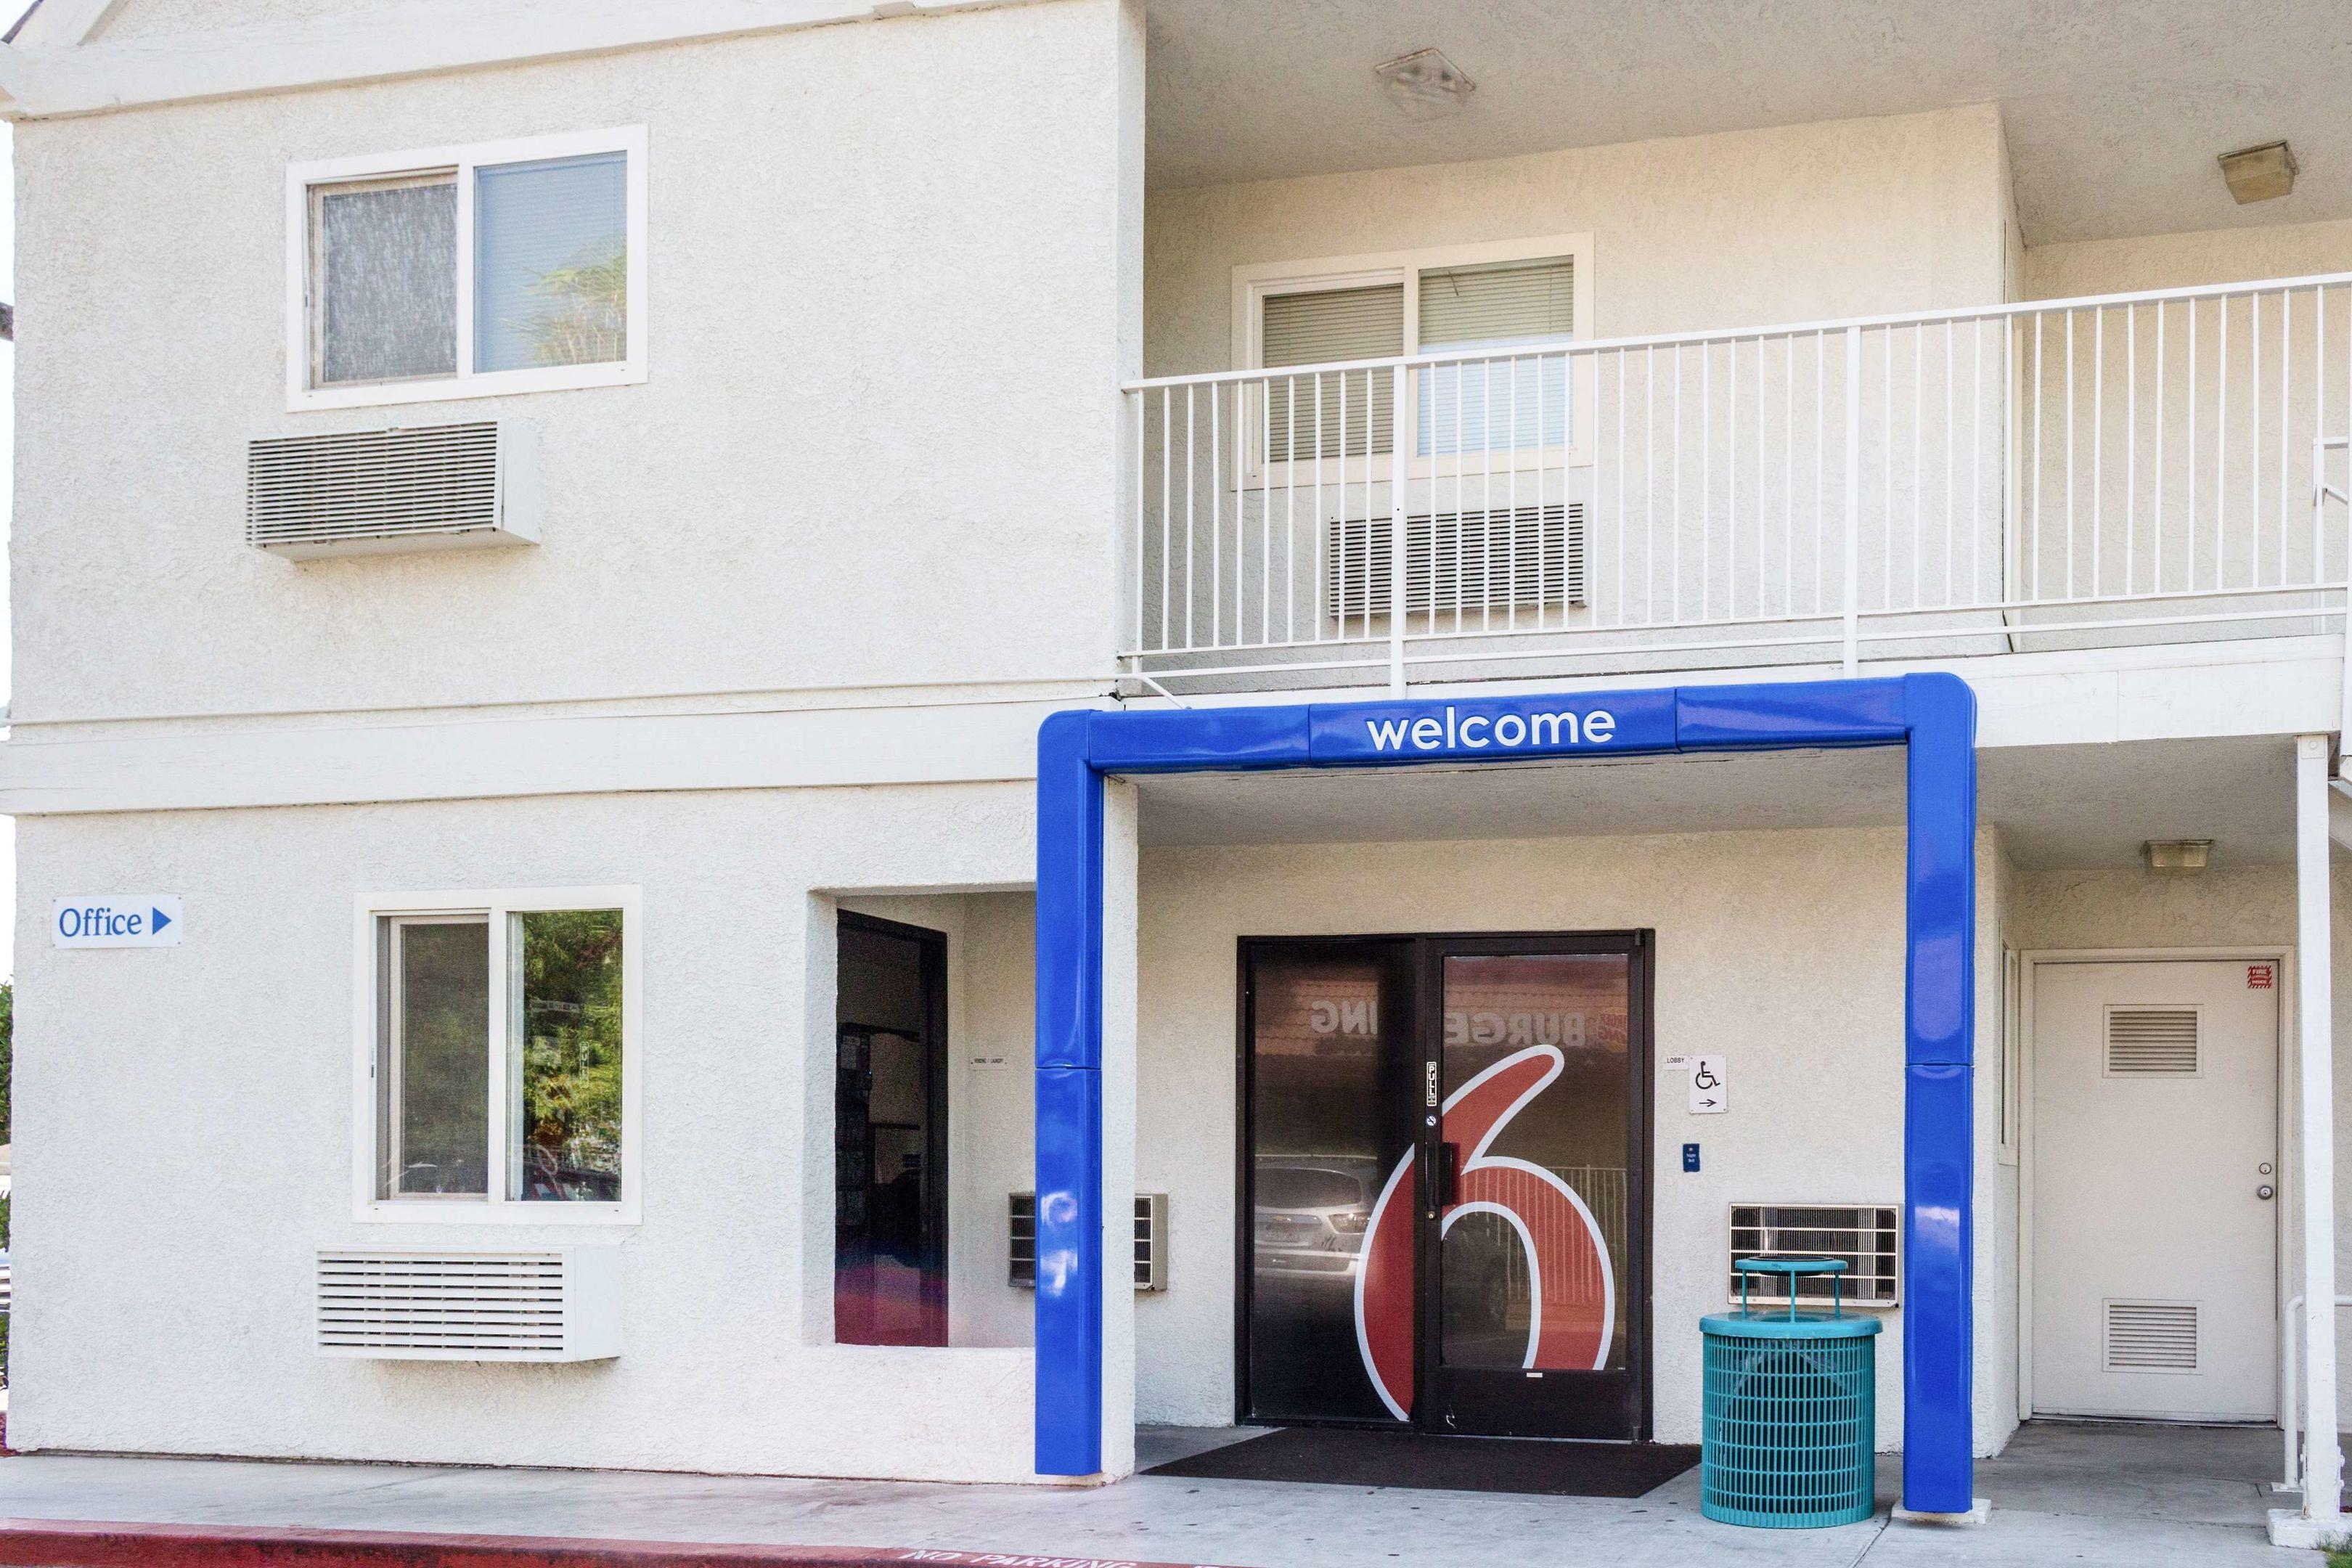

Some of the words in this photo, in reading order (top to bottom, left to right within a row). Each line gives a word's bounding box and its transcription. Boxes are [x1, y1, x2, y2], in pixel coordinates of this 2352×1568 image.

[1367, 706, 1615, 751] welcome
[59, 907, 142, 937] Office
[898, 1550, 963, 1561] NO
